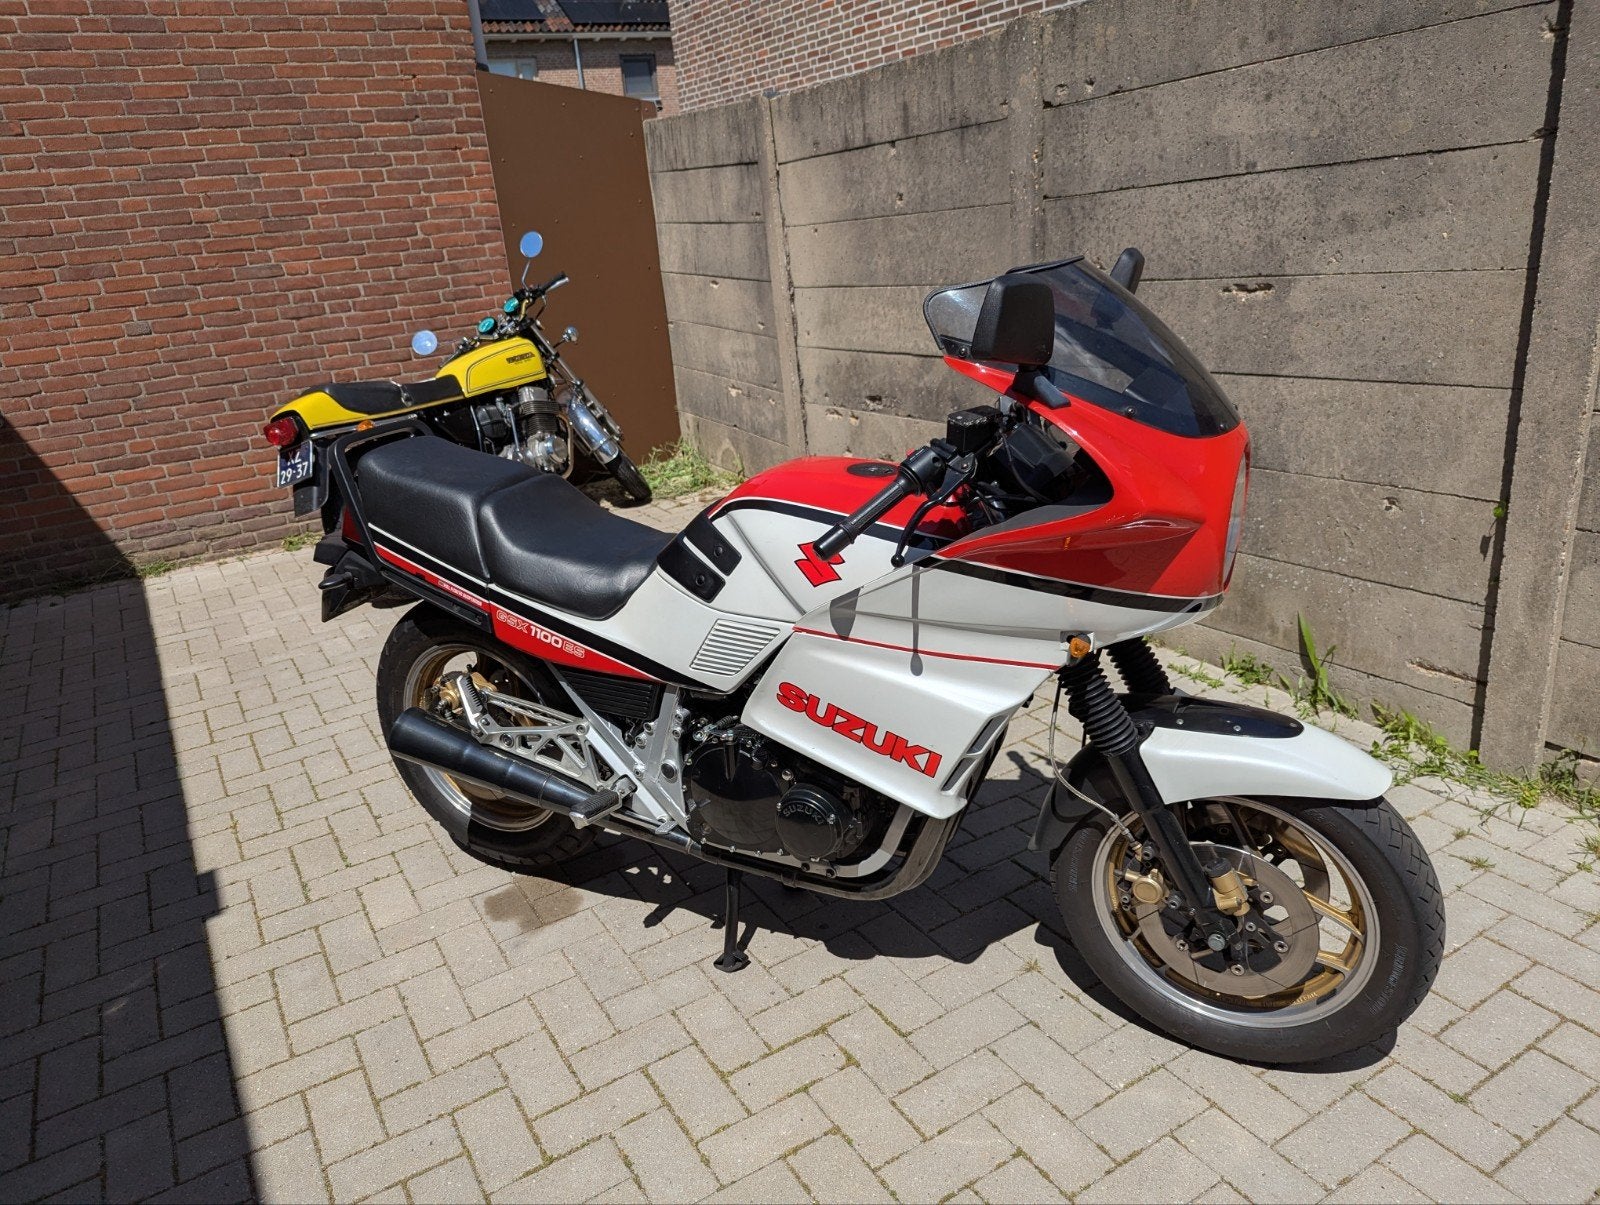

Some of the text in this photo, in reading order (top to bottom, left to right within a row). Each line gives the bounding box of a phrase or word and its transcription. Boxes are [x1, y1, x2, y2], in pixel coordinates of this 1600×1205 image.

[281, 461, 308, 484] 29-37
[496, 609, 528, 634] GSX
[776, 681, 942, 778] SUZUKI
